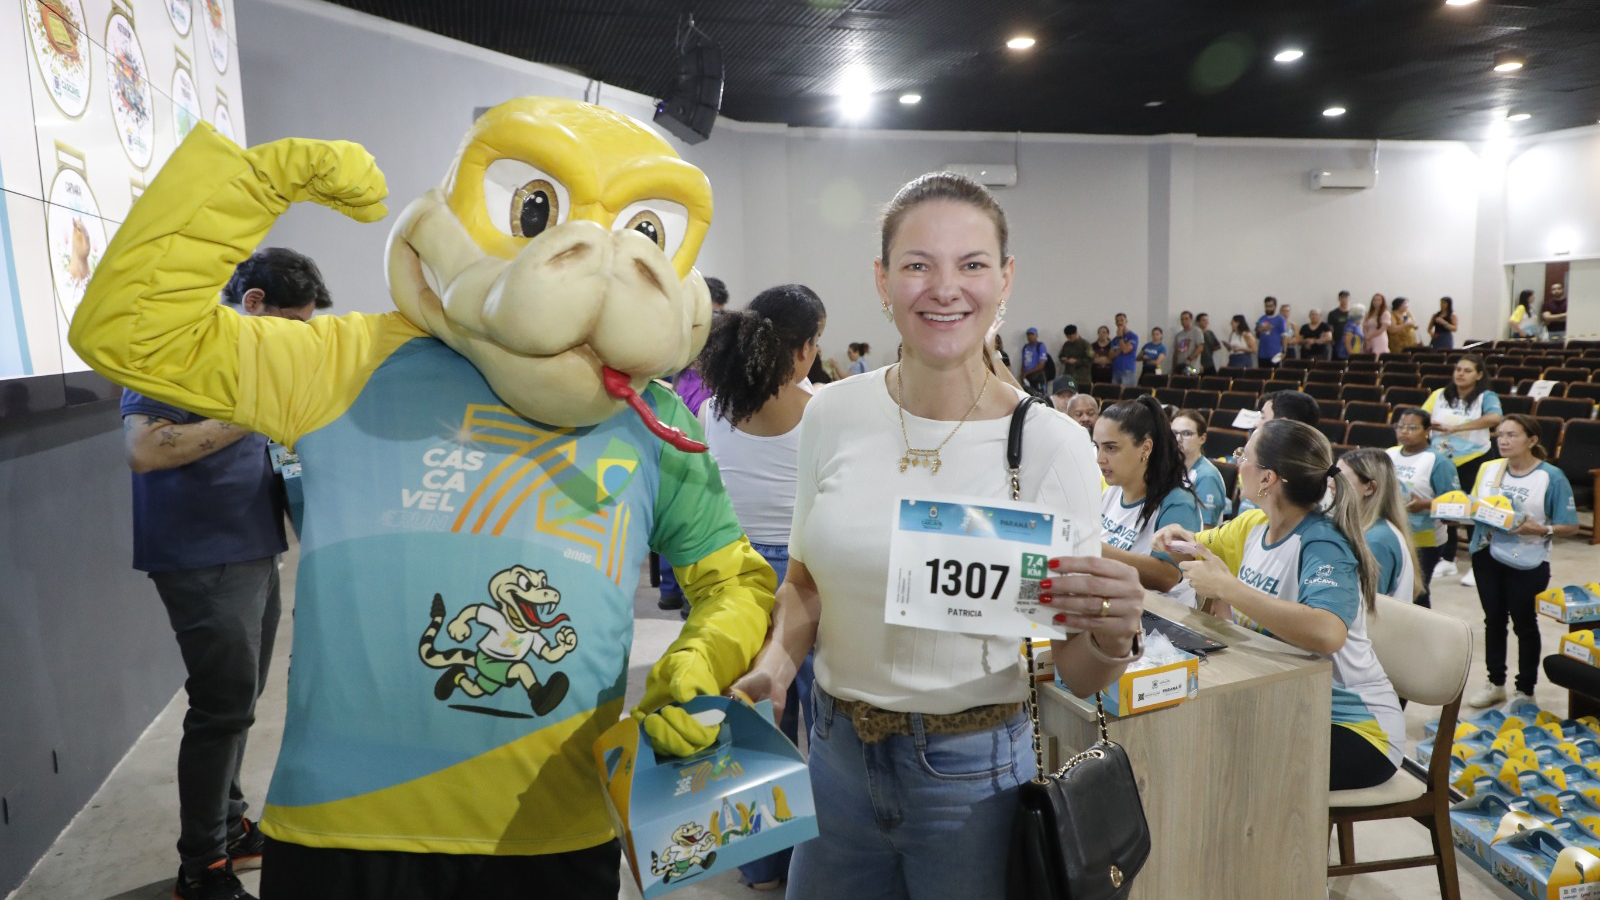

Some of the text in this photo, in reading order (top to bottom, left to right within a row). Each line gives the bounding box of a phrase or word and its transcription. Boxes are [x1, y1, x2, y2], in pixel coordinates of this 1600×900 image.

[422, 448, 486, 471] CAS
[422, 469, 466, 492] CA
[401, 488, 455, 512] VEL
[563, 547, 592, 564] anos
[1027, 555, 1044, 568] 7,4
[926, 558, 1010, 600] 1307
[1027, 568, 1042, 577] KM
[1239, 565, 1280, 596] ASCAVEL
[947, 608, 983, 617] PATRICIA
